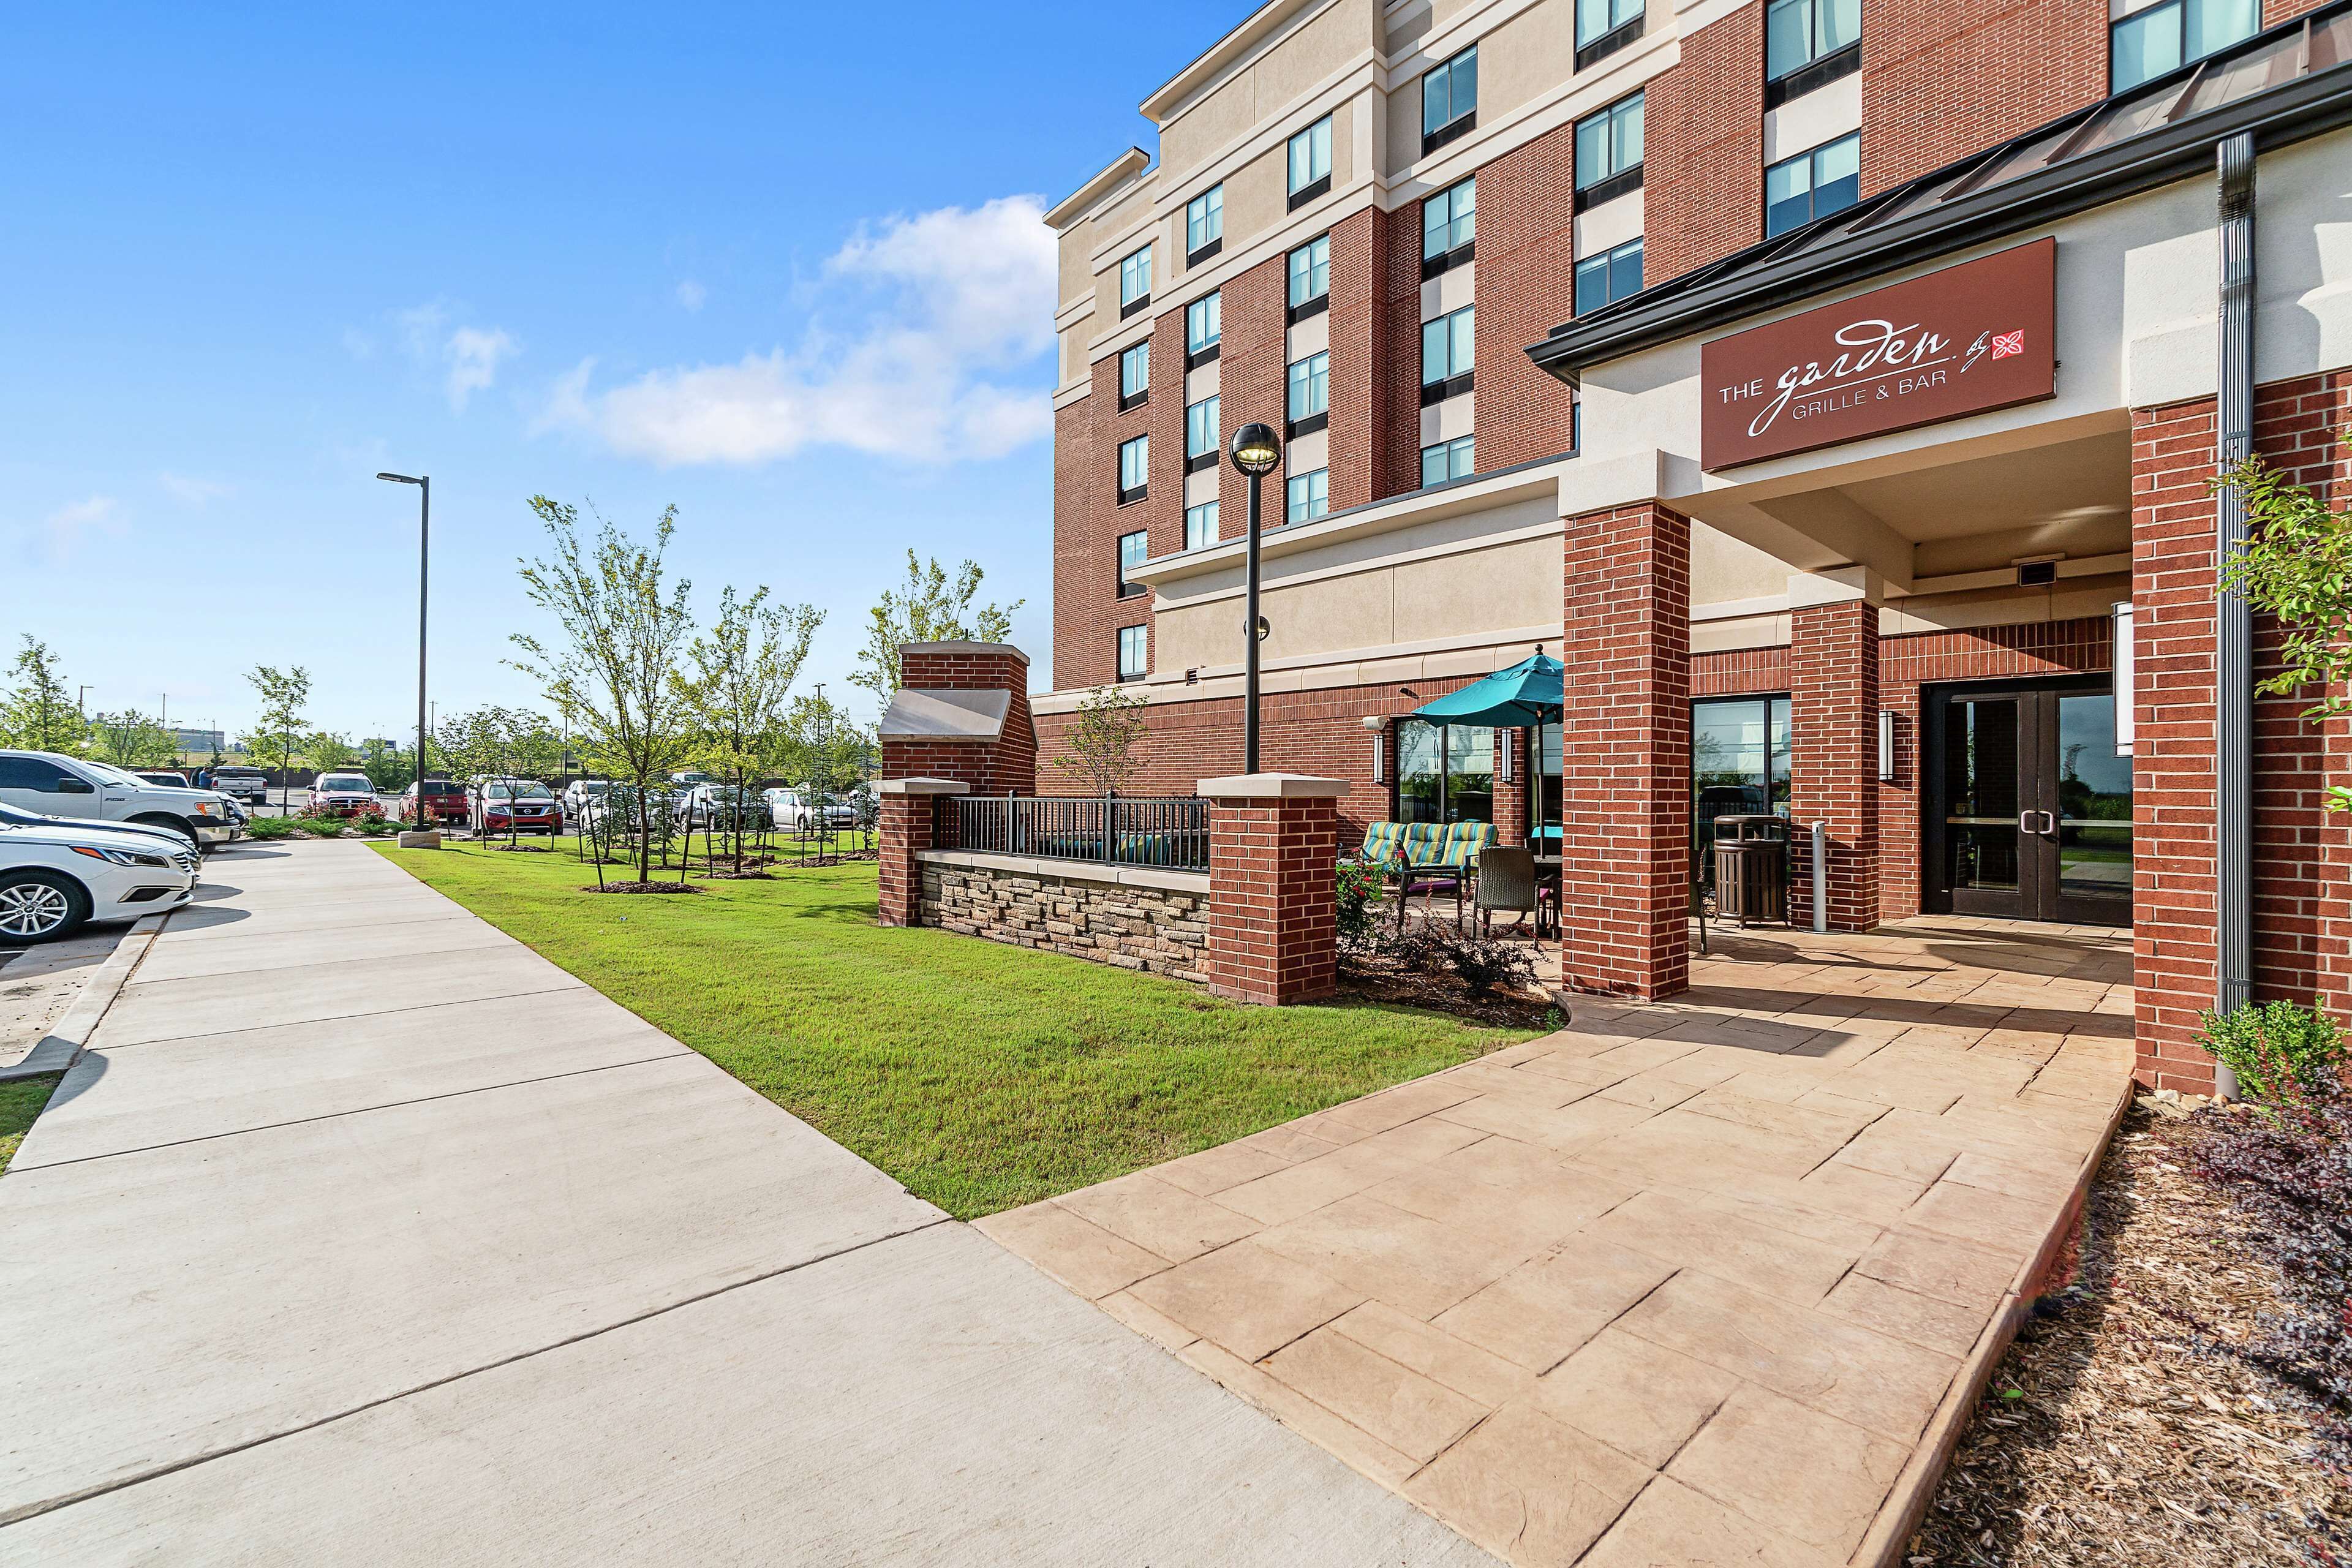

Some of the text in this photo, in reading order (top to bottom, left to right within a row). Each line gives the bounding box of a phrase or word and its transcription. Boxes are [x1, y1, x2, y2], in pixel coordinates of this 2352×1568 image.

[1719, 319, 1991, 437] THE garden by
[1792, 370, 1947, 420] GRILLE & BAR
